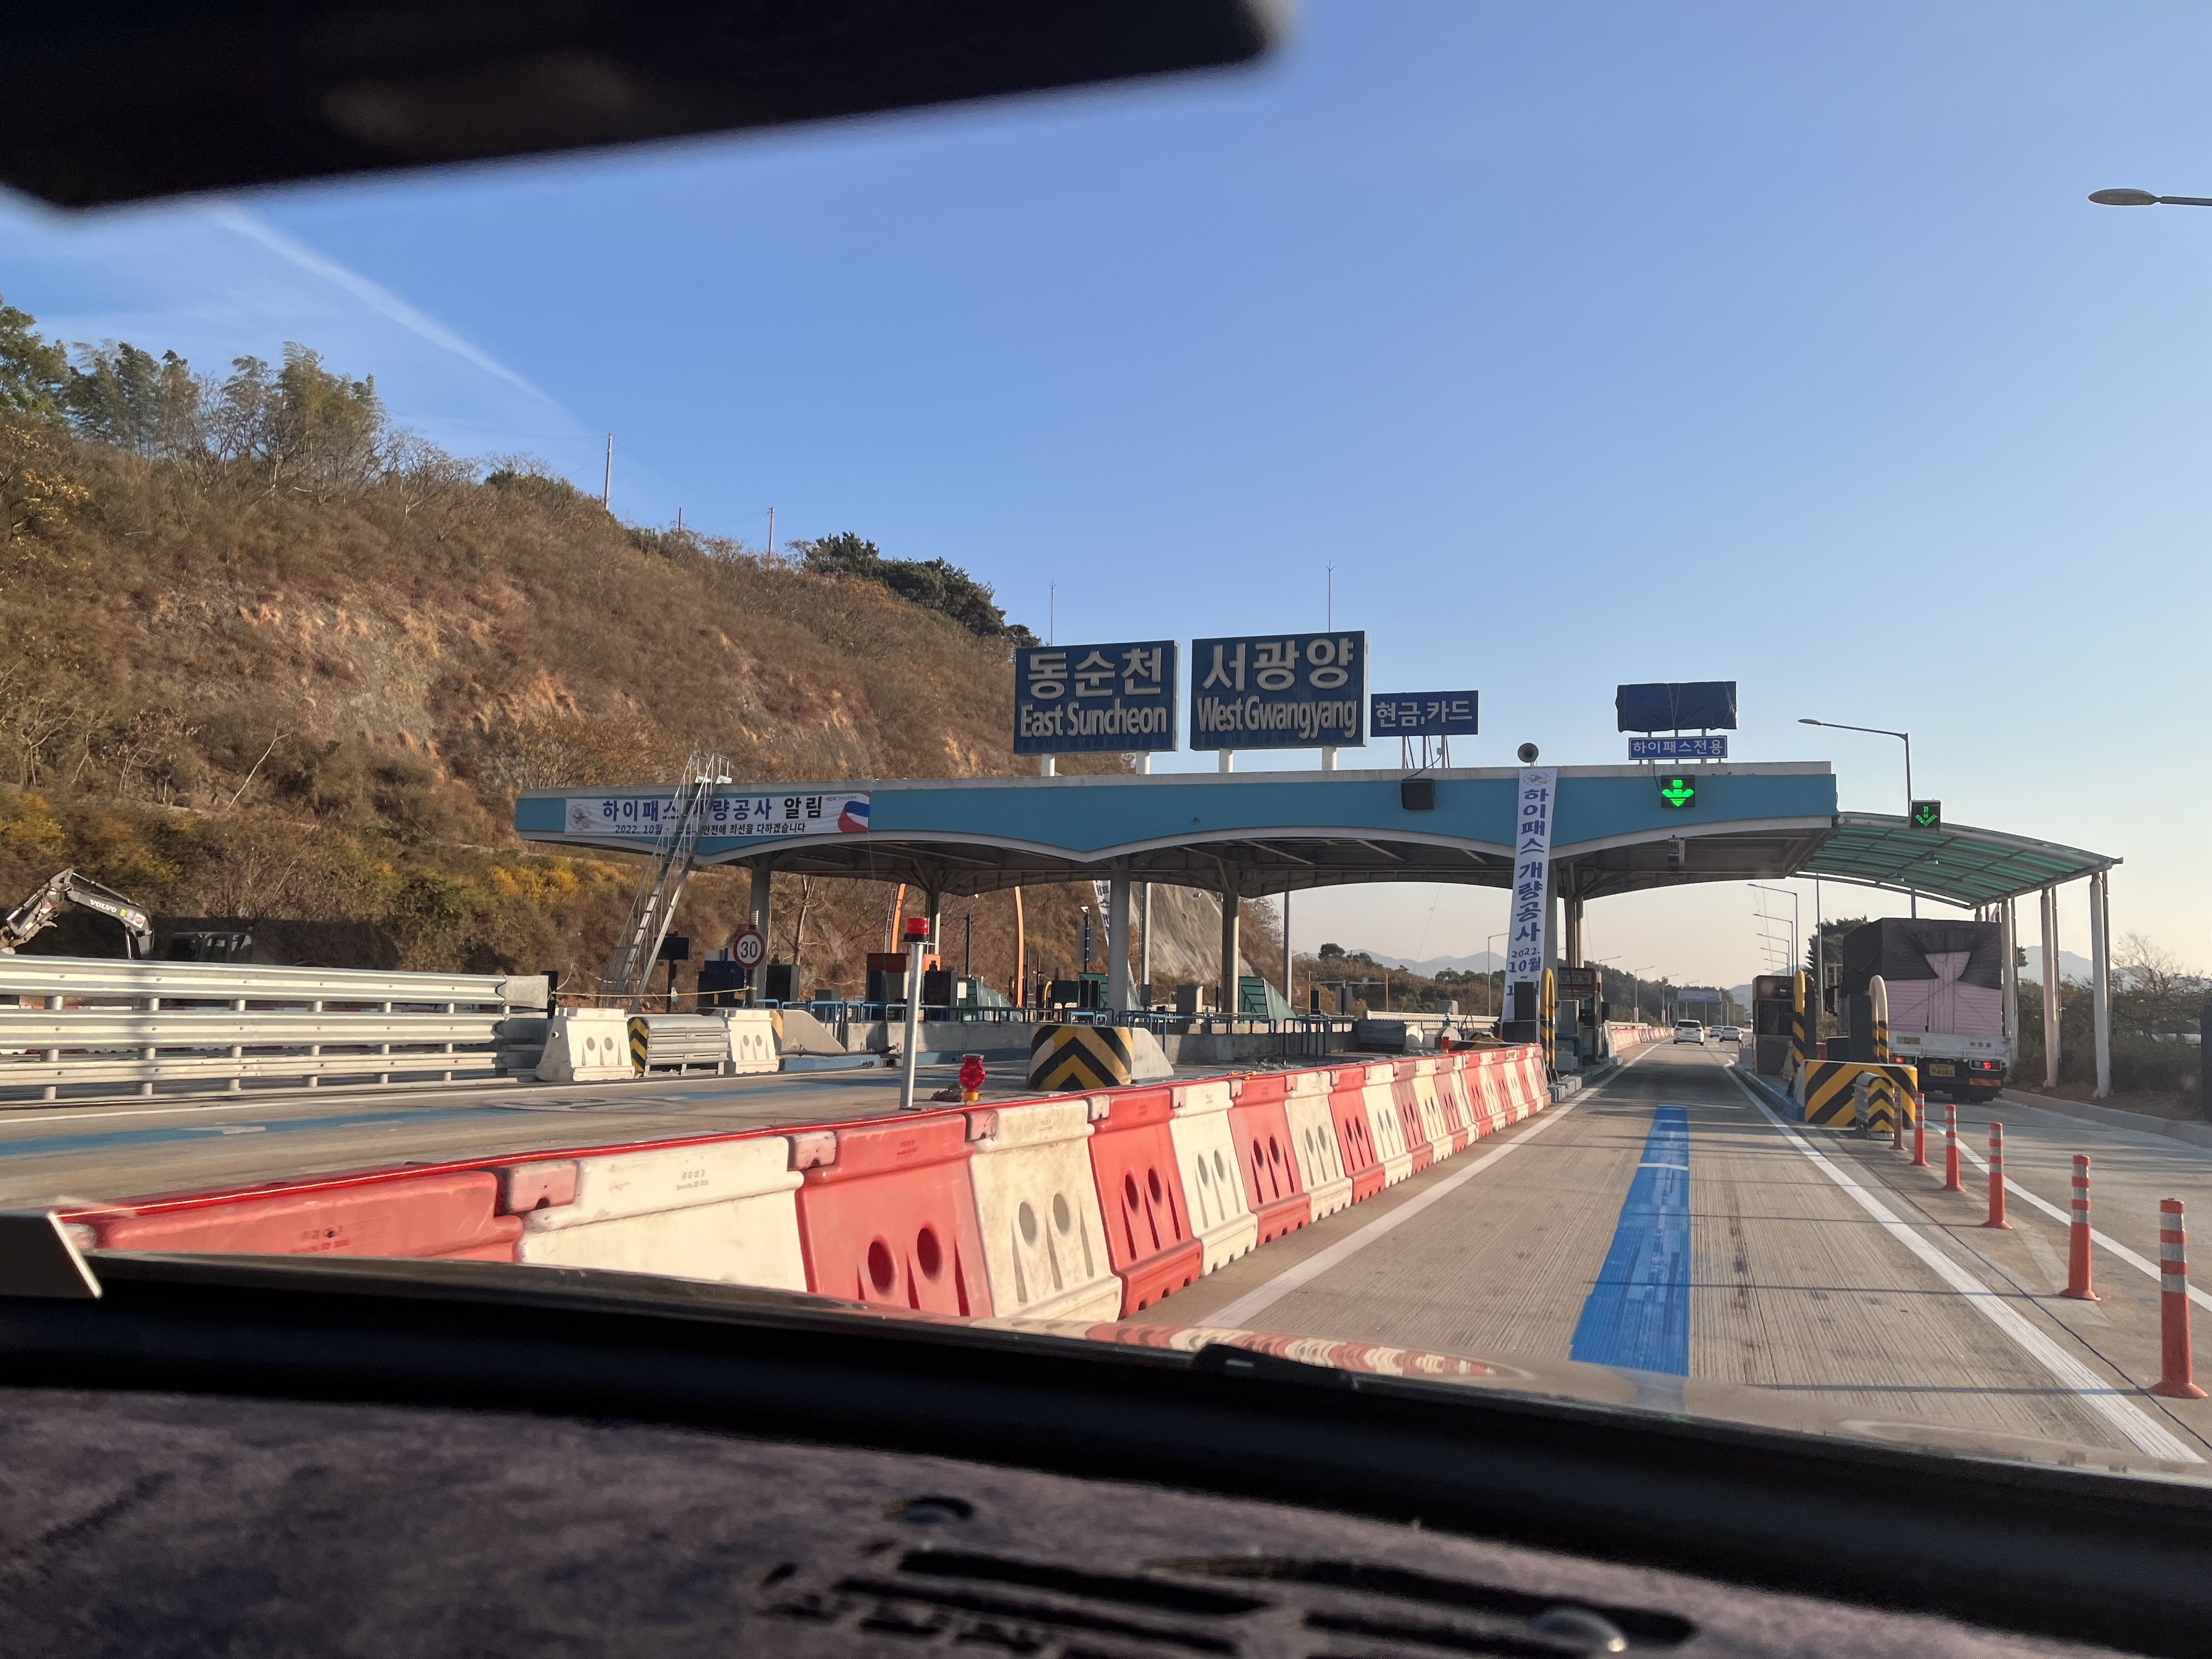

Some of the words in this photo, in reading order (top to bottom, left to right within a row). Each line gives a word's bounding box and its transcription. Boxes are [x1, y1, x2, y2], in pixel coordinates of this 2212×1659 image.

[1028, 646, 1163, 700] 동순천
[1203, 638, 1353, 692] 서광양
[1020, 704, 1064, 738] East
[1066, 698, 1167, 738] Suncheon
[1197, 696, 1243, 733] West
[1245, 695, 1357, 740] Gwangyang
[1375, 700, 1472, 728] 현금,카드
[1632, 739, 1723, 755] 하이패스전용
[602, 800, 679, 822] 하이패스
[784, 796, 822, 819] 알림
[1519, 788, 1550, 855] 하이패스
[614, 824, 640, 834] 2022.
[644, 823, 663, 835] 10월
[702, 824, 726, 835] 안전에
[730, 823, 753, 835] 최선을
[757, 822, 805, 834] 다하겠습니다
[89, 899, 117, 913] VOLVO
[1514, 861, 1543, 943] 개량공사
[740, 941, 758, 958] 30
[1511, 947, 1541, 958] 2022.
[1509, 957, 1541, 973] 10월
